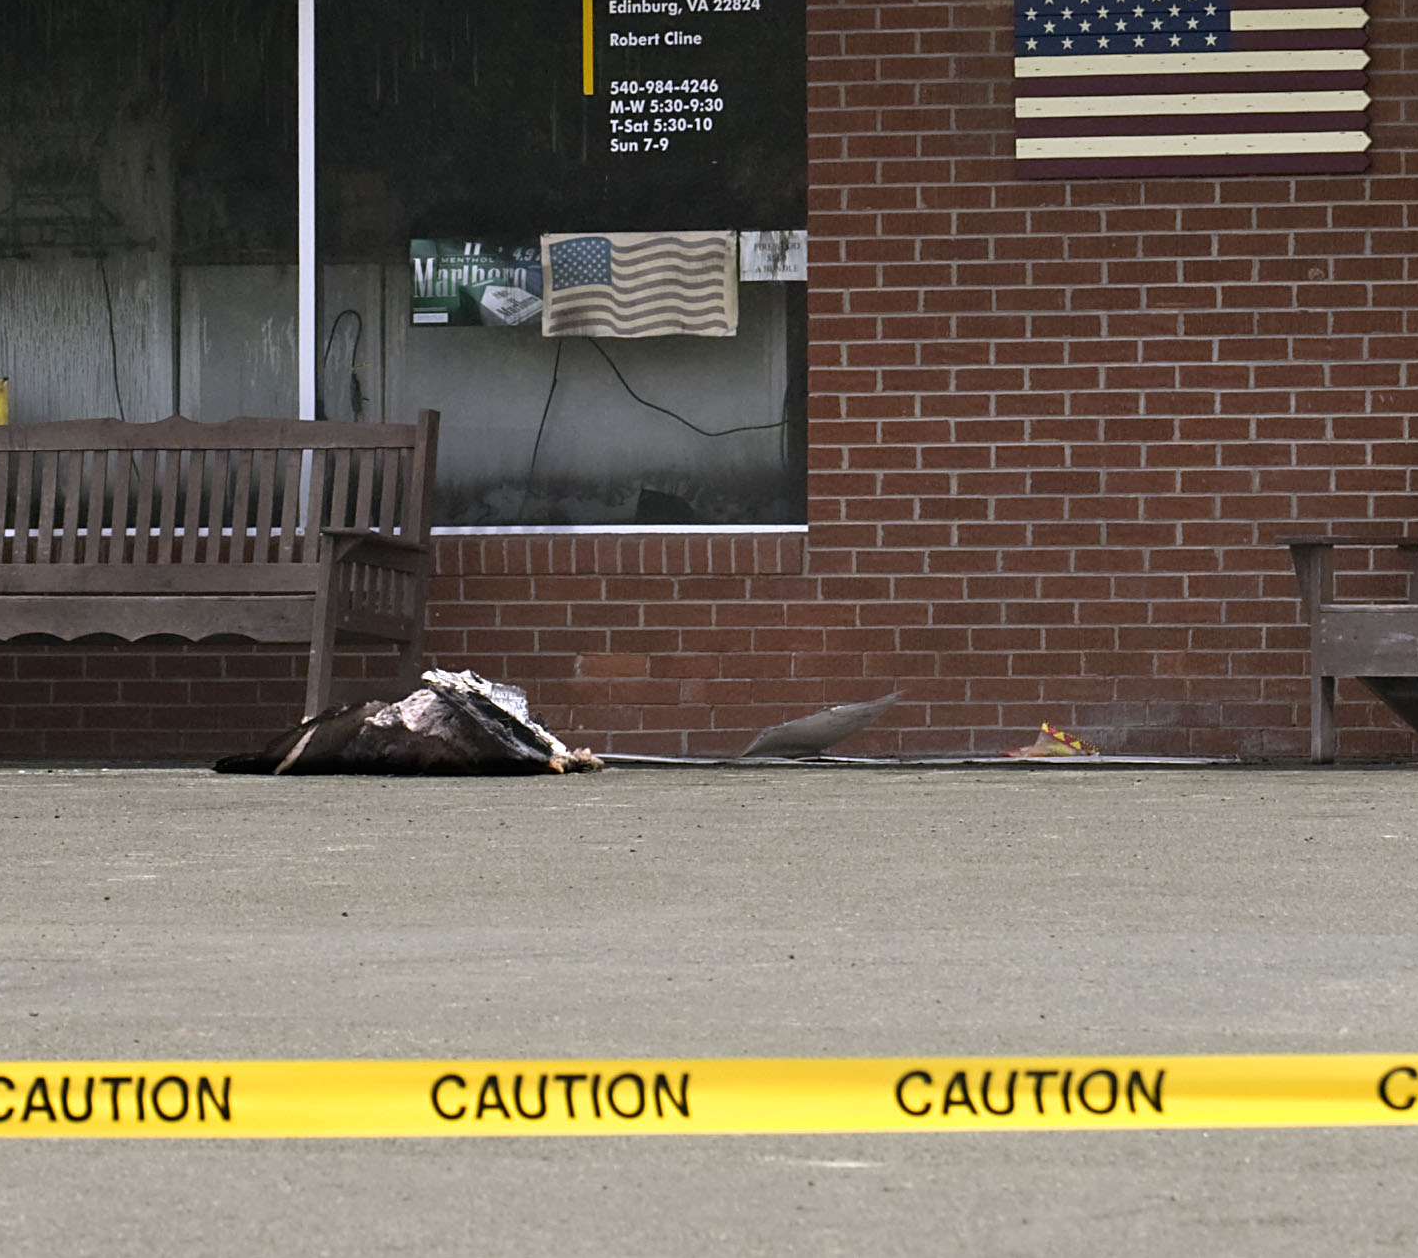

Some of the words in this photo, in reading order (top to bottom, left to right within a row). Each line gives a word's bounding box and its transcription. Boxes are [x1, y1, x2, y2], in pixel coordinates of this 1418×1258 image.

[609, 0, 683, 17] Edinburg,
[609, 32, 661, 47] Robert
[664, 31, 703, 46] Cline
[609, 79, 719, 95] 540-984-4246
[609, 99, 646, 115] M-W
[649, 97, 724, 114] 5:30-9:30
[609, 119, 650, 134] T-Sat
[653, 118, 713, 133] 5:30-10
[610, 138, 639, 153] Sun
[643, 137, 670, 152] 7-9
[413, 242, 528, 298] Marlboro
[431, 1071, 691, 1121] CAUTION
[894, 1067, 1166, 1117] CAUTION
